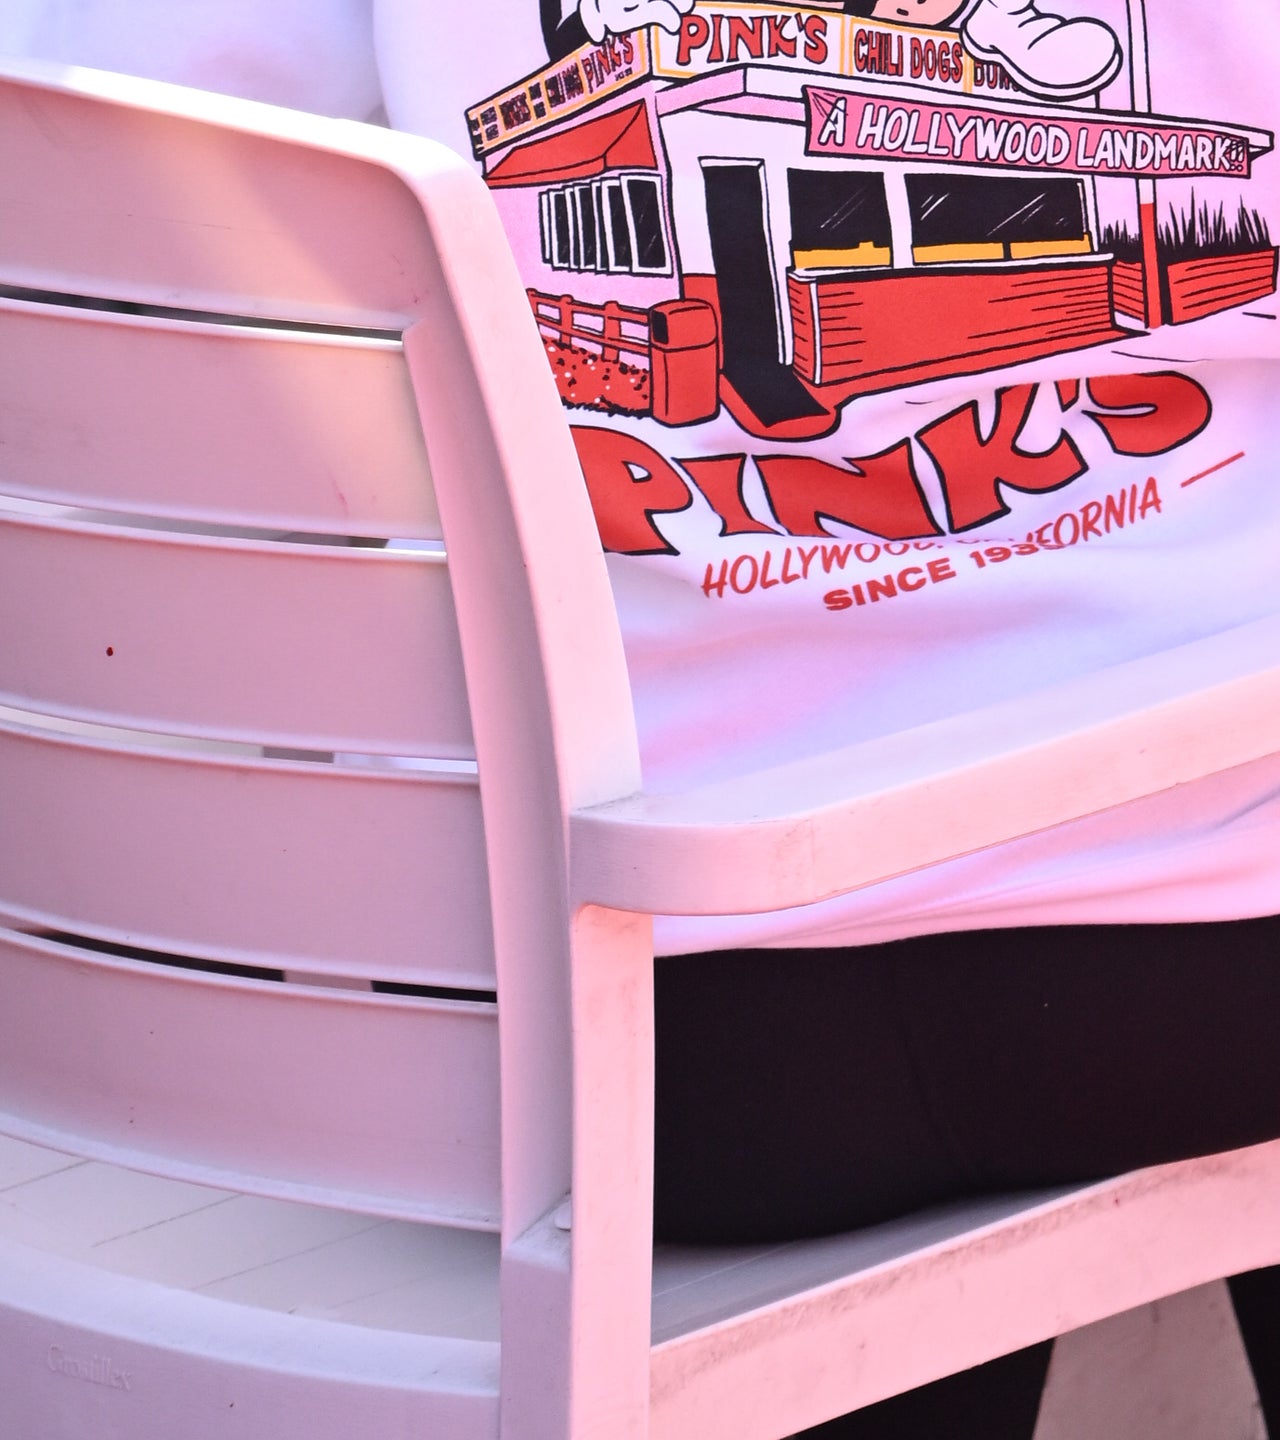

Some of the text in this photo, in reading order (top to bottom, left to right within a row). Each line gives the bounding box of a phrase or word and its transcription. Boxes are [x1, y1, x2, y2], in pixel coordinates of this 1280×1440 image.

[675, 12, 829, 66] PINK'S
[854, 28, 904, 78] CHILI
[910, 37, 963, 84] DOGS
[818, 97, 848, 145] A
[855, 101, 1072, 168] HOLLYWOOD
[566, 370, 1213, 556] PINK'S
[822, 543, 1068, 612] SINCE 193
